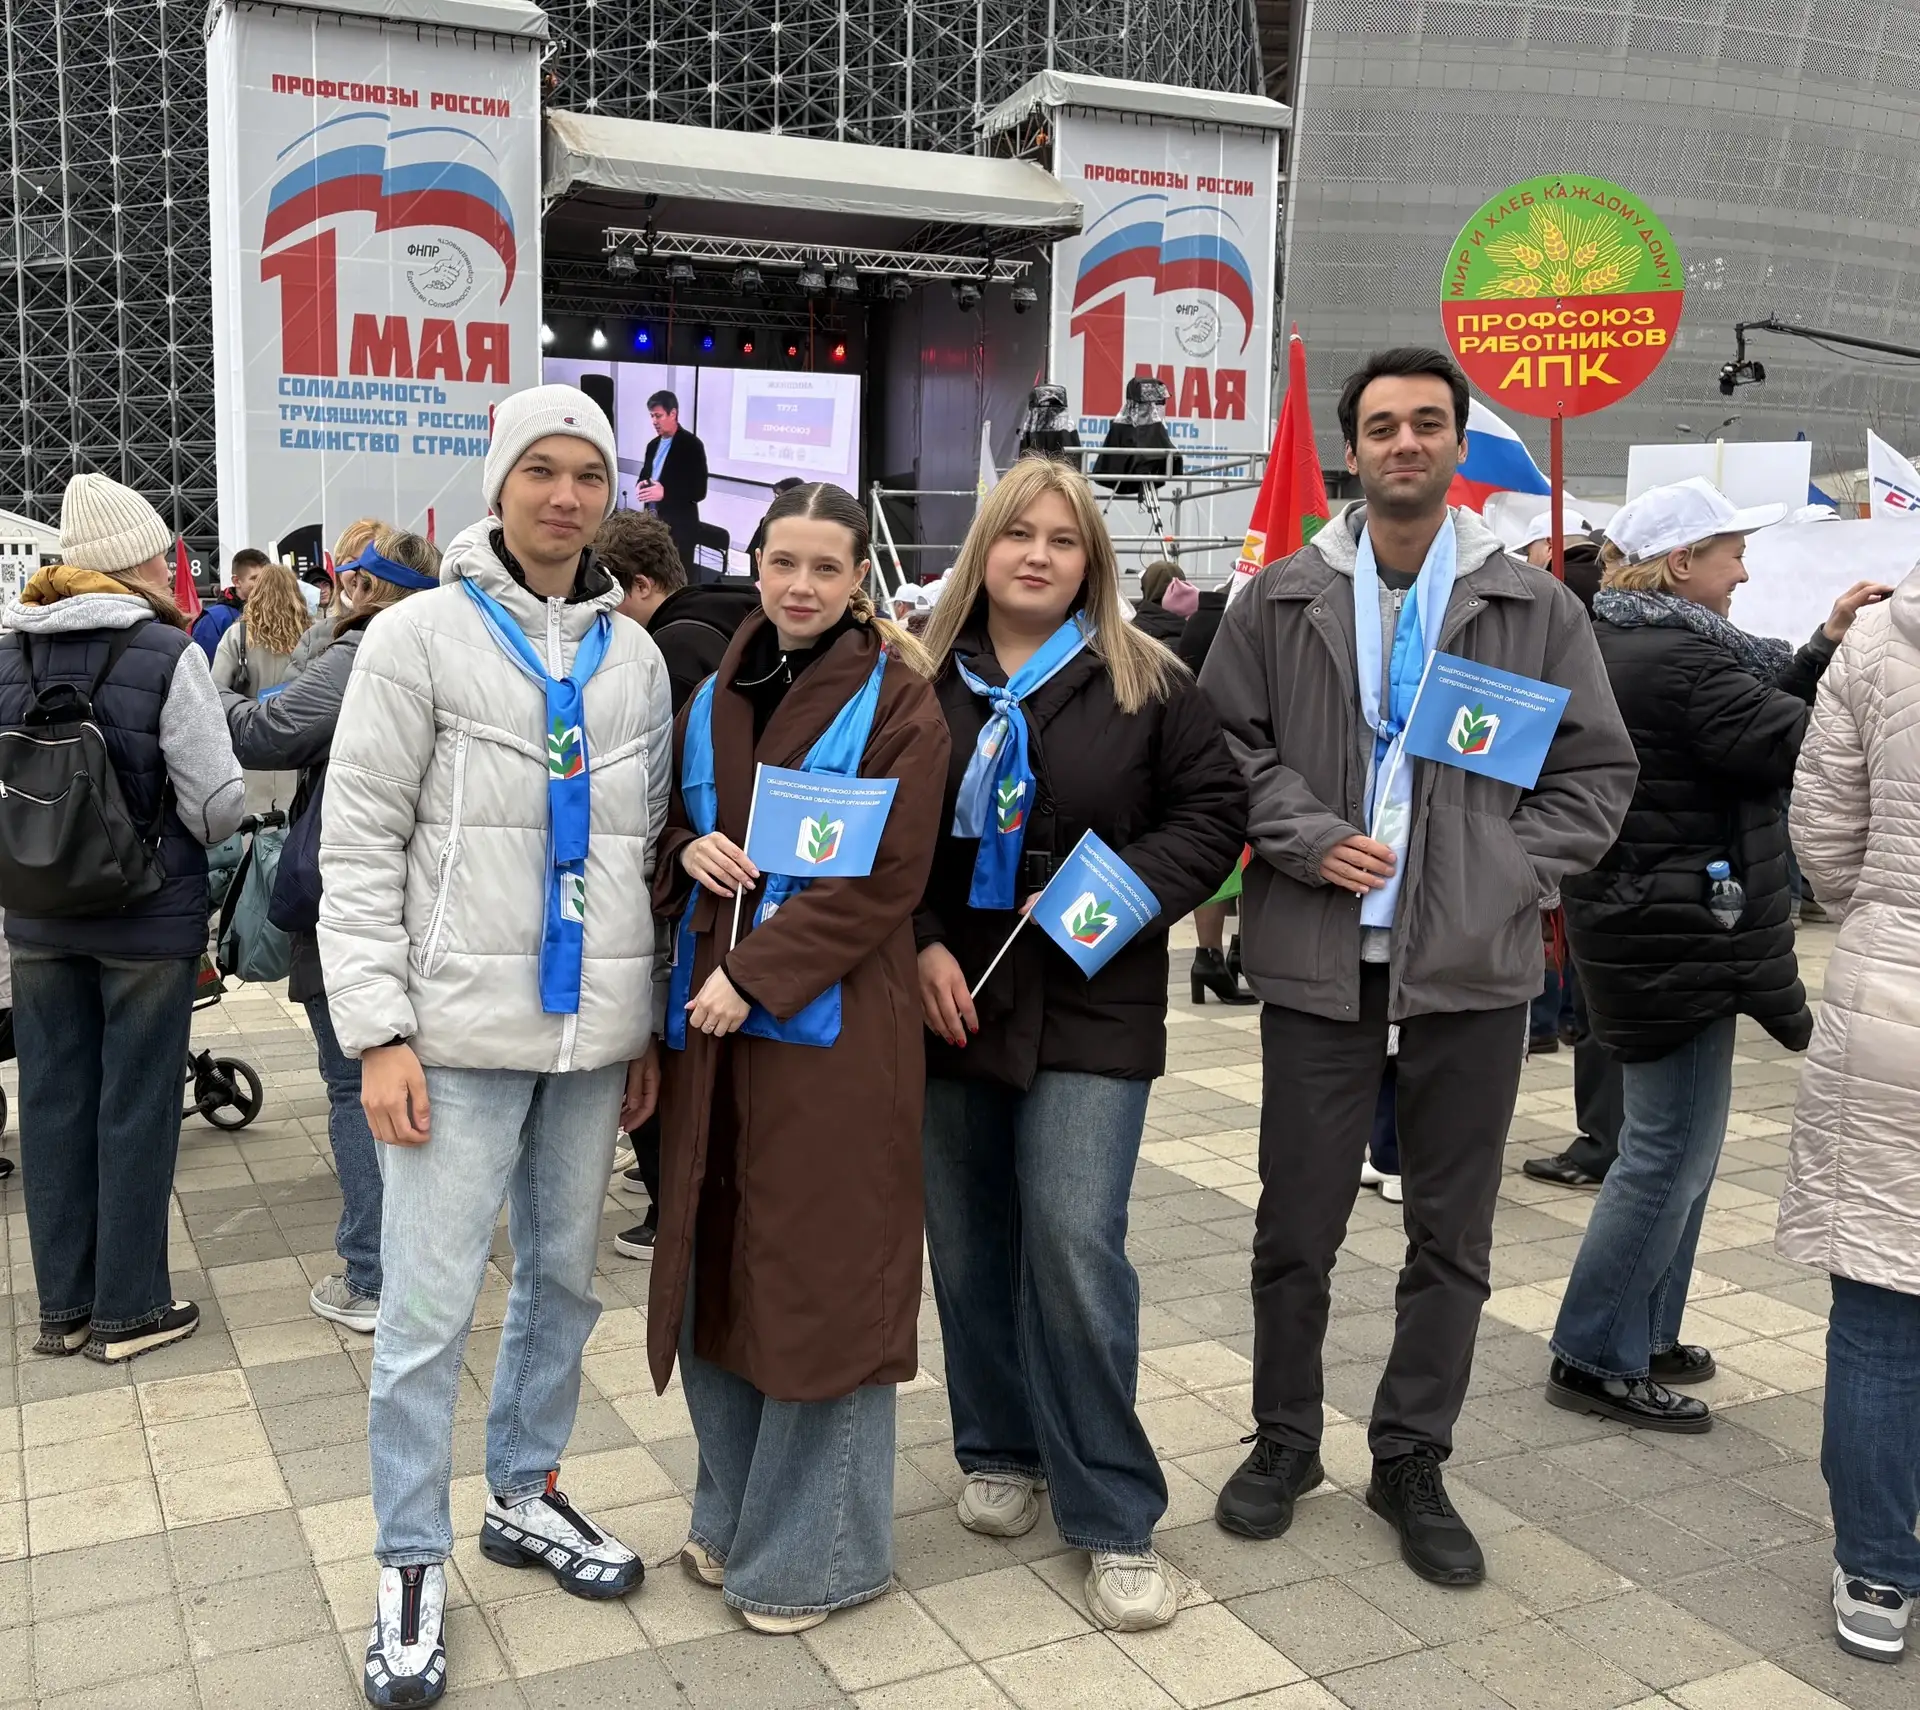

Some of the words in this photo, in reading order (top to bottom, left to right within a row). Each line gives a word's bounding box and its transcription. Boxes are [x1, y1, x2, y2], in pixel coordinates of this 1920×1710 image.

[272, 73, 419, 108] ПРОФСОЮЗЫ
[431, 91, 510, 118] РОССИИ
[1084, 163, 1188, 191] ПРОФСОЮЗЫ
[1196, 176, 1254, 197] РОССИИ
[407, 243, 440, 258] ФНПР
[1450, 249, 1472, 297] МИР
[1469, 229, 1486, 247] И
[1484, 191, 1536, 230] ХЛЕБ
[1543, 184, 1646, 227] КАЖДОМУ
[260, 226, 339, 378] 1
[349, 312, 511, 385] МАЯ
[1457, 307, 1656, 333] ПРОФСОЮЗ
[1070, 290, 1126, 417] 1
[1459, 328, 1667, 354] РАБОТНИКОВ
[1498, 352, 1622, 390] АПК
[278, 377, 446, 405] СОЛИДАРНОСТЬ
[278, 403, 408, 427] ТРУДЯЩИХСЯ
[417, 411, 489, 431] РОССИИ
[776, 404, 798, 412] ТРУД
[279, 428, 400, 453] ЕДИНСТВО
[763, 424, 811, 435] ПРОФСОЮЗ
[190, 559, 202, 577] 8
